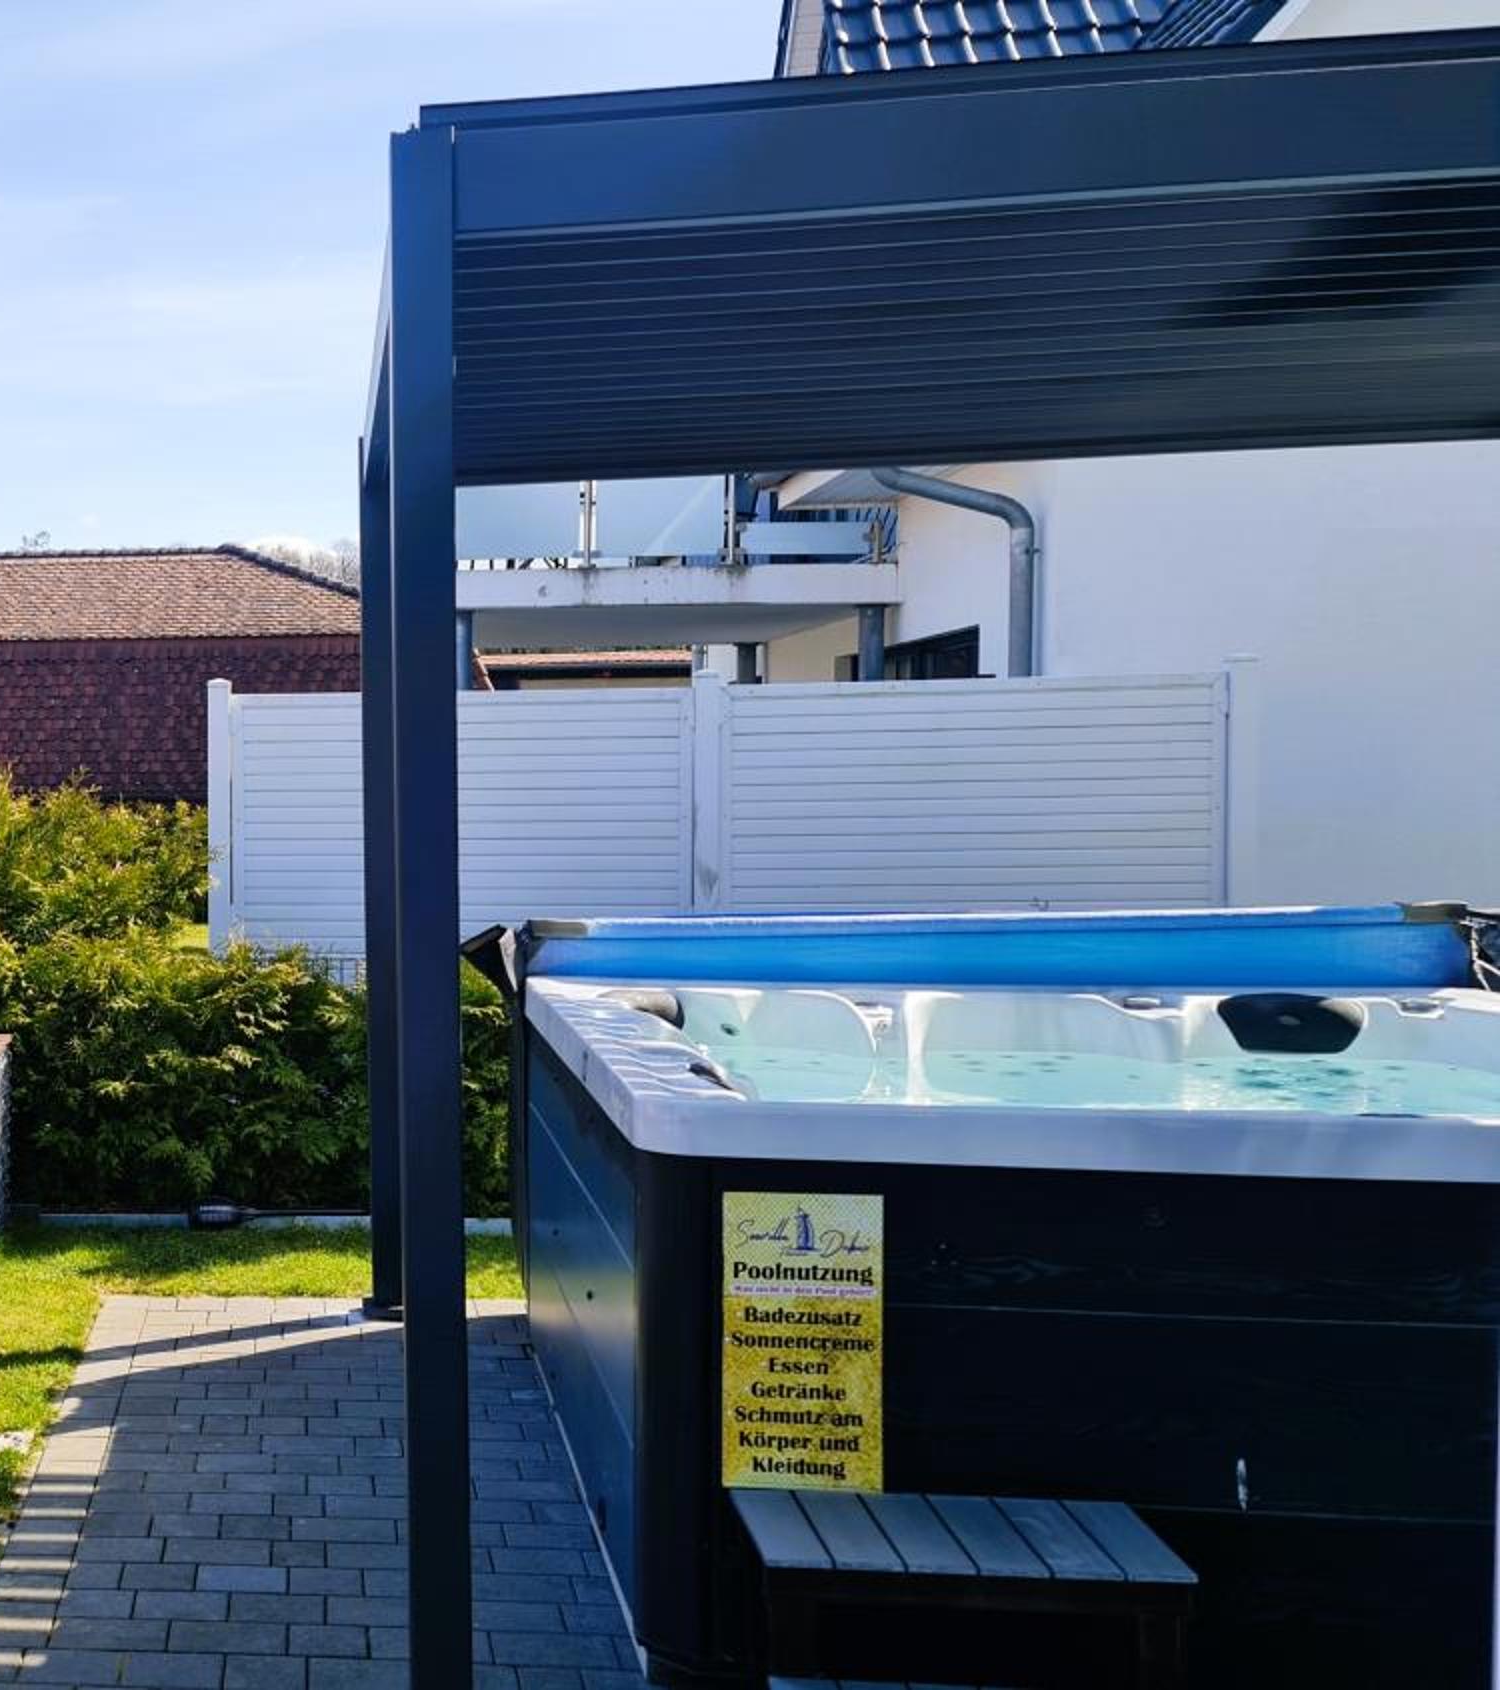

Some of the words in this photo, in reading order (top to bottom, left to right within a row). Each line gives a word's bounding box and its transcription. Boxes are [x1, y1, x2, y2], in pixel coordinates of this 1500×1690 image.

[733, 1261, 873, 1286] Poolnutzung
[743, 1306, 862, 1327] Badezusatz
[731, 1332, 874, 1352] Sonnencreme
[767, 1357, 829, 1375] Essen
[751, 1381, 846, 1401] Getränke
[734, 1405, 826, 1426] Schmutz
[830, 1413, 863, 1427] am
[739, 1432, 812, 1451] Körper
[820, 1435, 860, 1452] und
[753, 1457, 846, 1480] Kleidung
